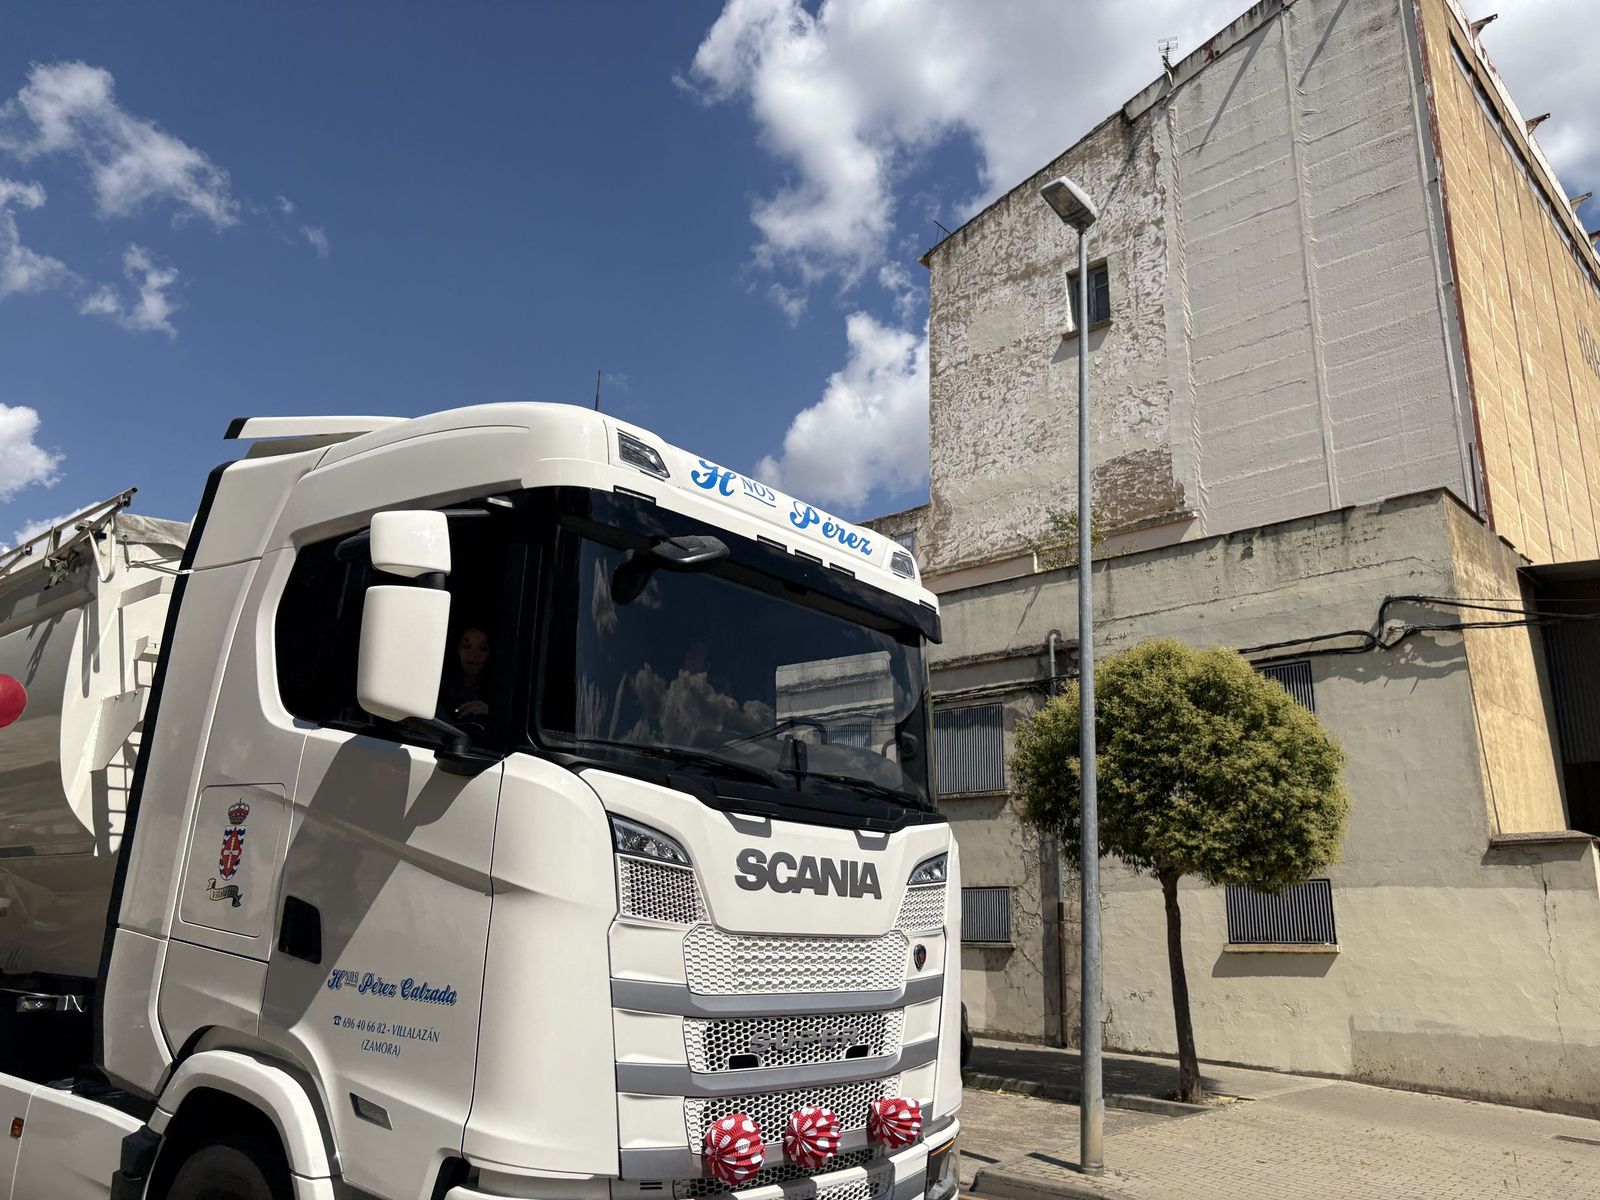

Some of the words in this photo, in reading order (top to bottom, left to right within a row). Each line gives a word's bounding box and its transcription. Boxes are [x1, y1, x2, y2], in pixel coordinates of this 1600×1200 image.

[734, 848, 882, 900] SCANIA
[358, 972, 398, 998] Pérez
[400, 977, 458, 1007] Calzada
[342, 1016, 355, 1029] 696
[356, 1019, 366, 1032] 40
[366, 1020, 376, 1033] 66
[376, 1022, 387, 1035] 82
[392, 1024, 441, 1043] VILLALAZÁN
[750, 1027, 860, 1053] SUPER
[361, 1039, 401, 1058] (ZAMORA)
